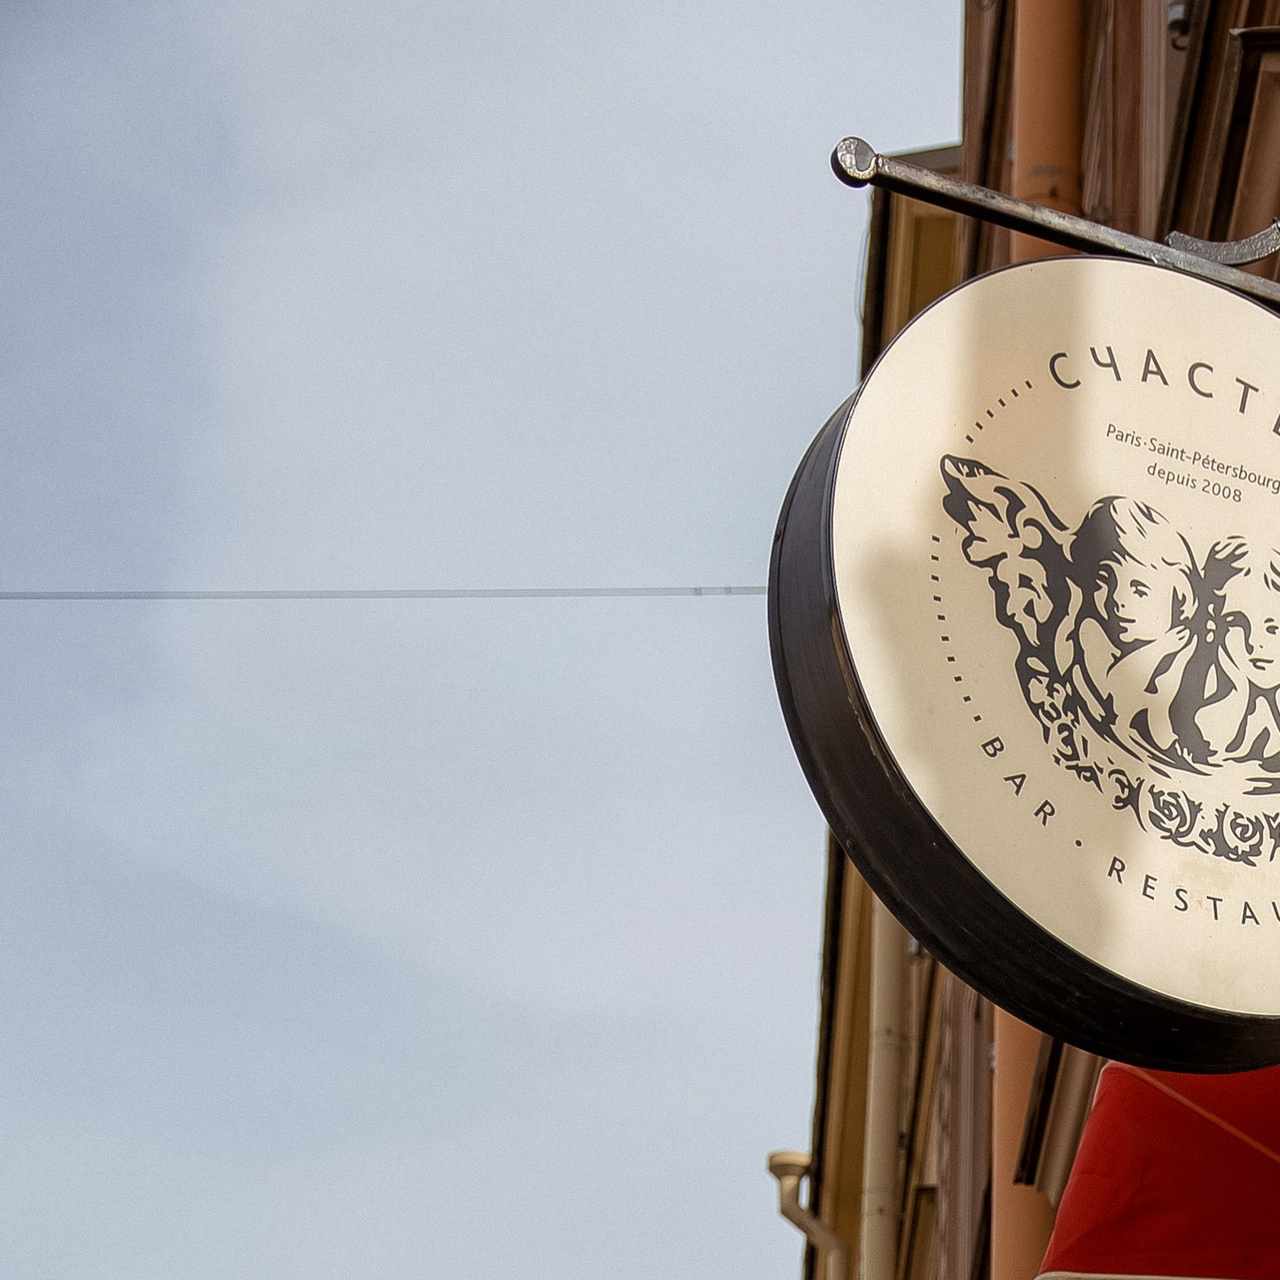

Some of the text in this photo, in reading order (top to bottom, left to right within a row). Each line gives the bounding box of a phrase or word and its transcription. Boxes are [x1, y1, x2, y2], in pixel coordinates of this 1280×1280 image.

[1147, 463, 1243, 503] depuis 2008
[981, 736, 1056, 826] BAR
